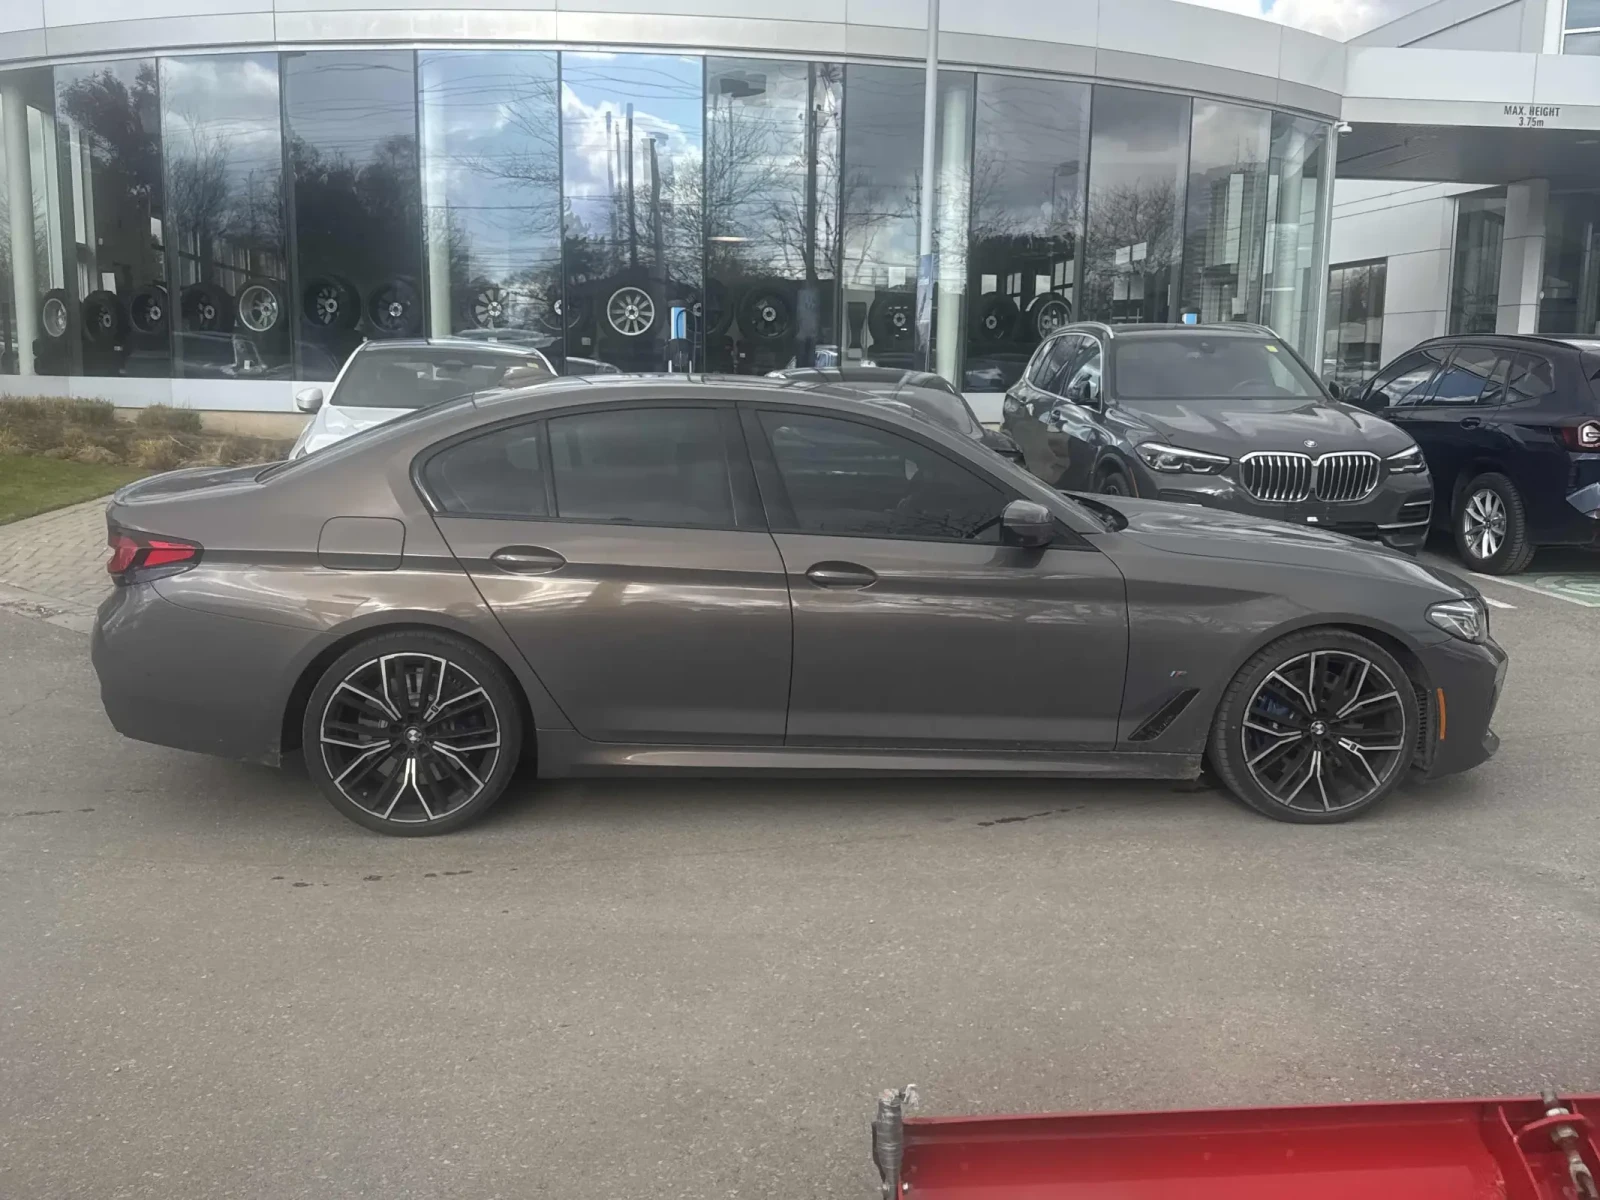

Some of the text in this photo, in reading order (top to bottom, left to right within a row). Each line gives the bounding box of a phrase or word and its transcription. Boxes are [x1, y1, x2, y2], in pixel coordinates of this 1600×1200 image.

[1503, 105, 1561, 117] MAX. HEIGHT
[1518, 116, 1544, 127] 3.75m
